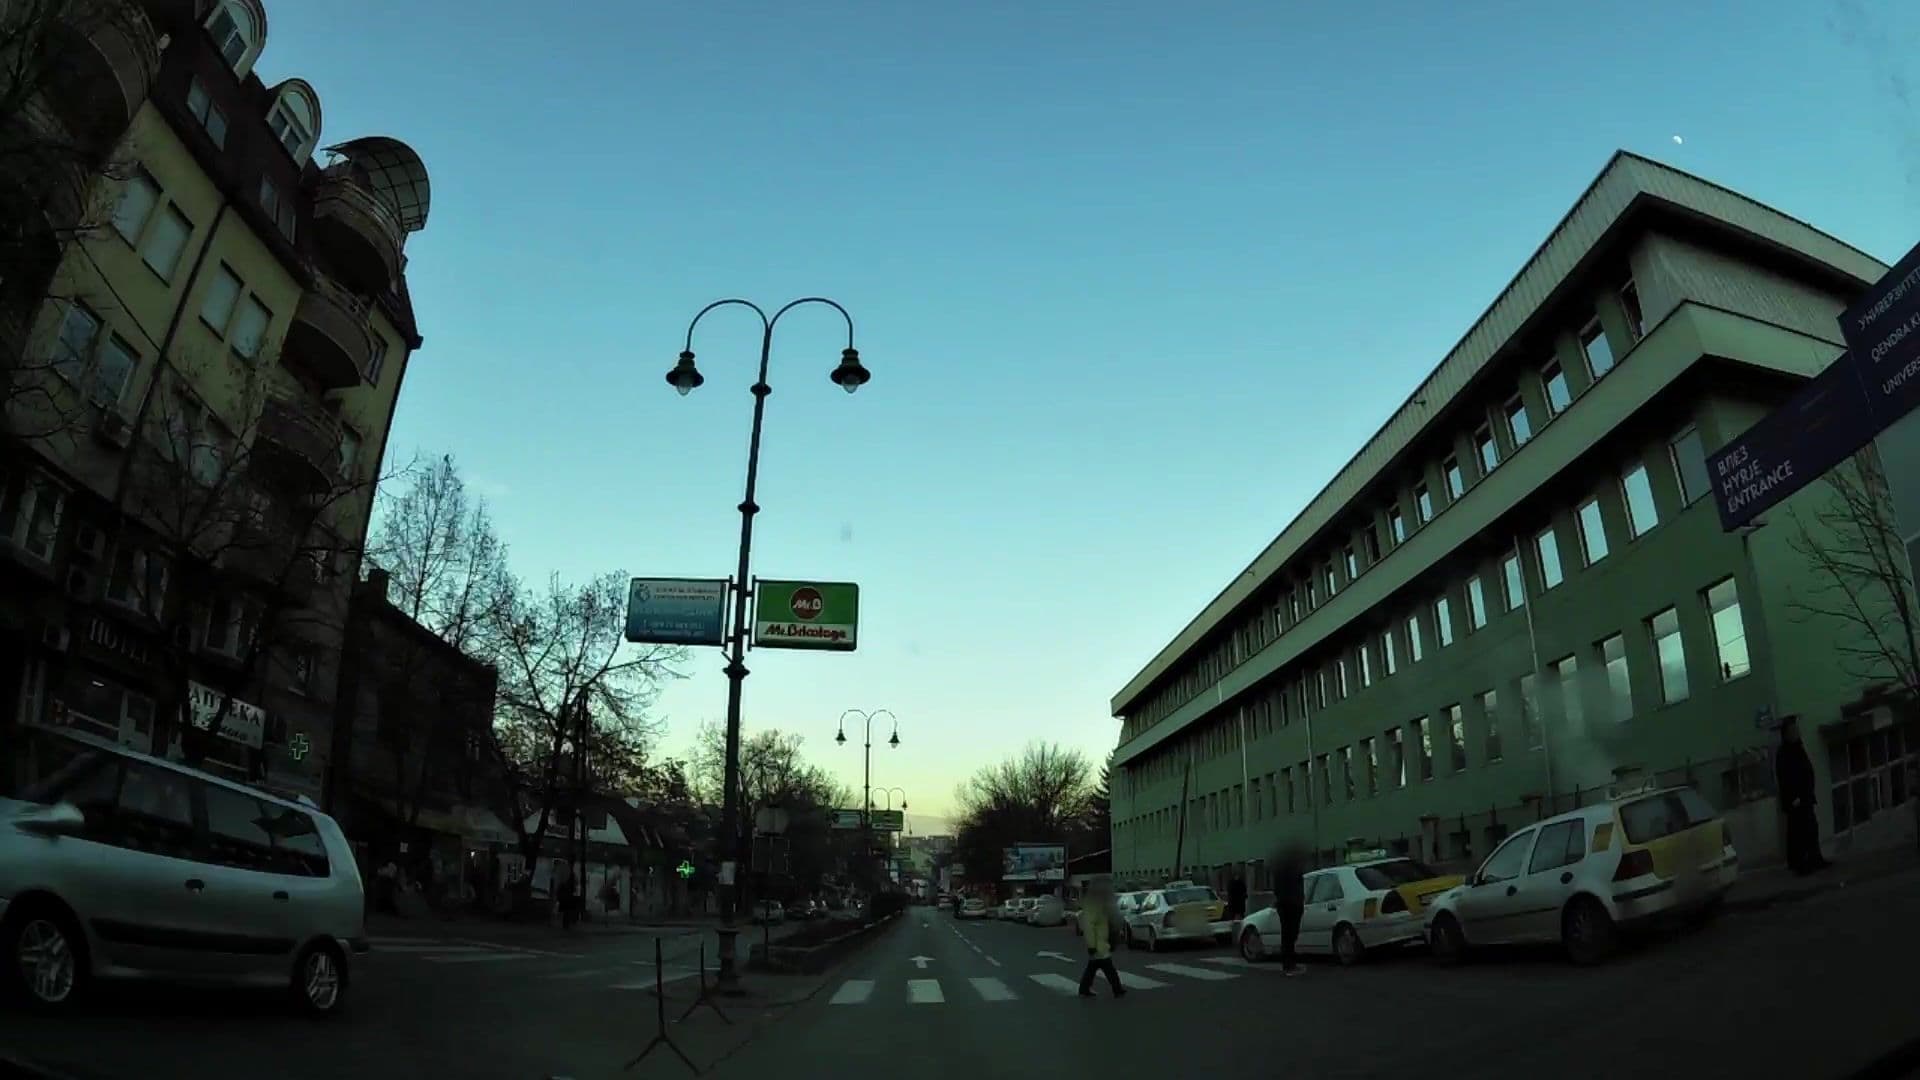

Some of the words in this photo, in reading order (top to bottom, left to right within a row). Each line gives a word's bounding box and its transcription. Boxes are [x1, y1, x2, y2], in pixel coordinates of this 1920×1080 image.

[1872, 323, 1911, 363] QENDRA
[1717, 444, 1749, 477] ВЛЕЗ
[1722, 458, 1761, 496] HYRJE
[1727, 459, 1793, 513] ENTRANCE
